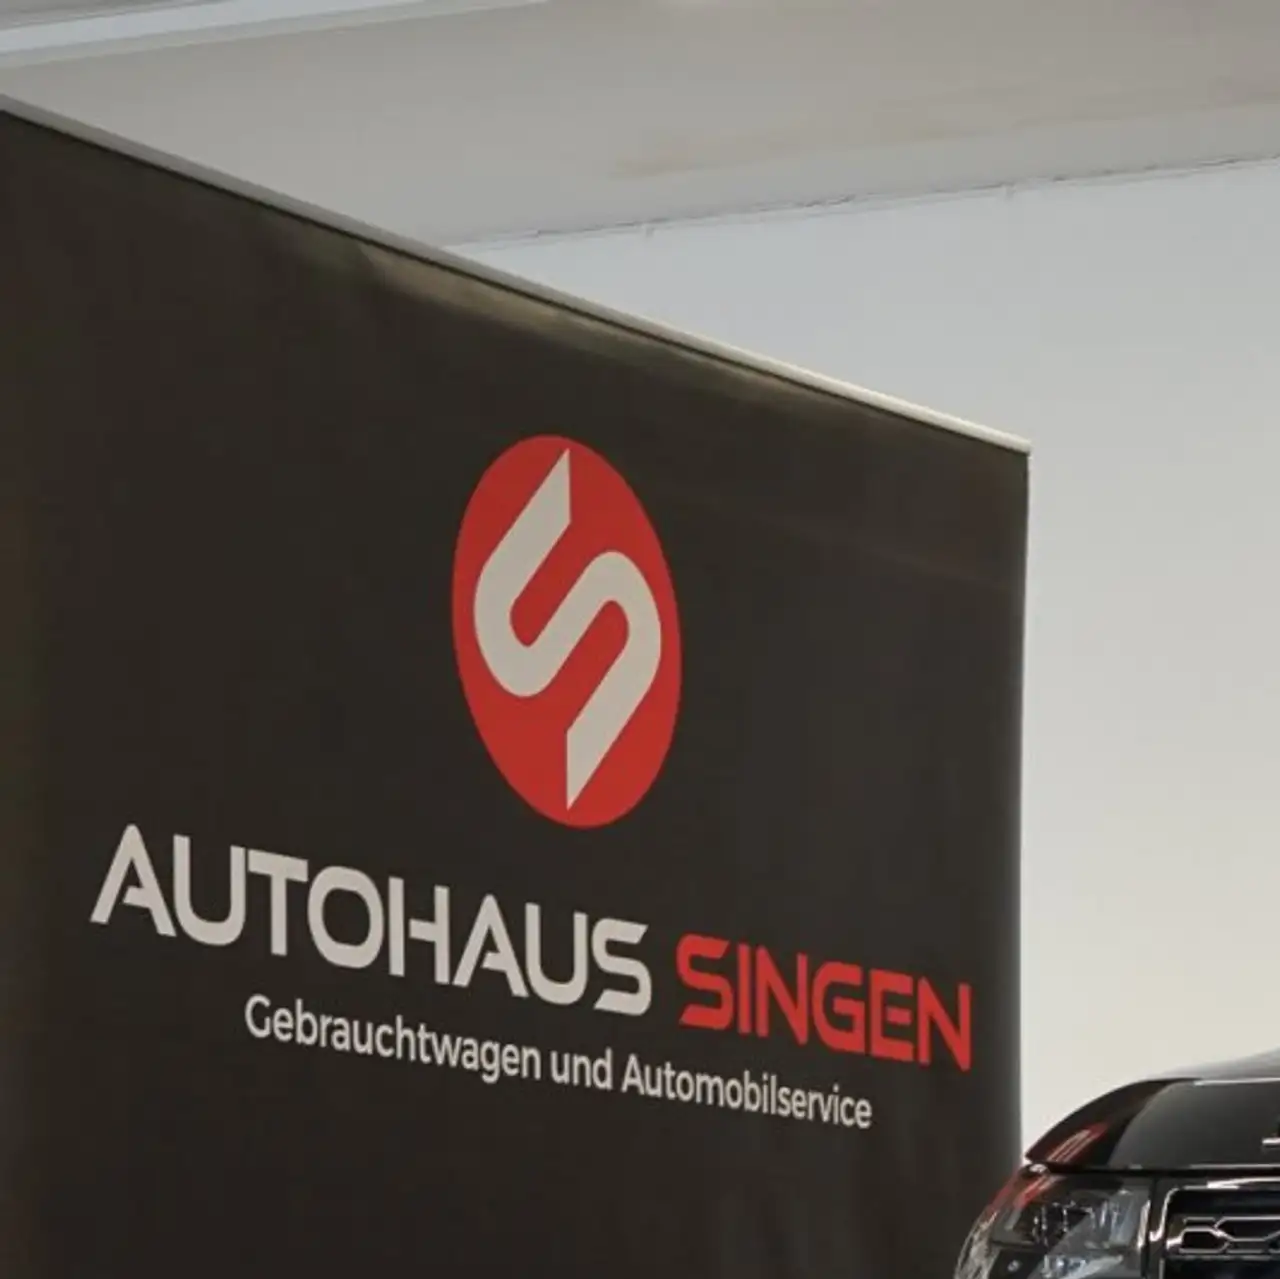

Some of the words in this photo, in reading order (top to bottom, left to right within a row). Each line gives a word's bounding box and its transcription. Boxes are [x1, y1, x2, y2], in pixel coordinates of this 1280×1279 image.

[88, 822, 654, 1017] AUTOHAUS
[675, 932, 972, 1073] SINGEN
[244, 993, 542, 1085] Gebrauchtwagen
[551, 1050, 613, 1094] und
[620, 1053, 874, 1130] Automobilservice
